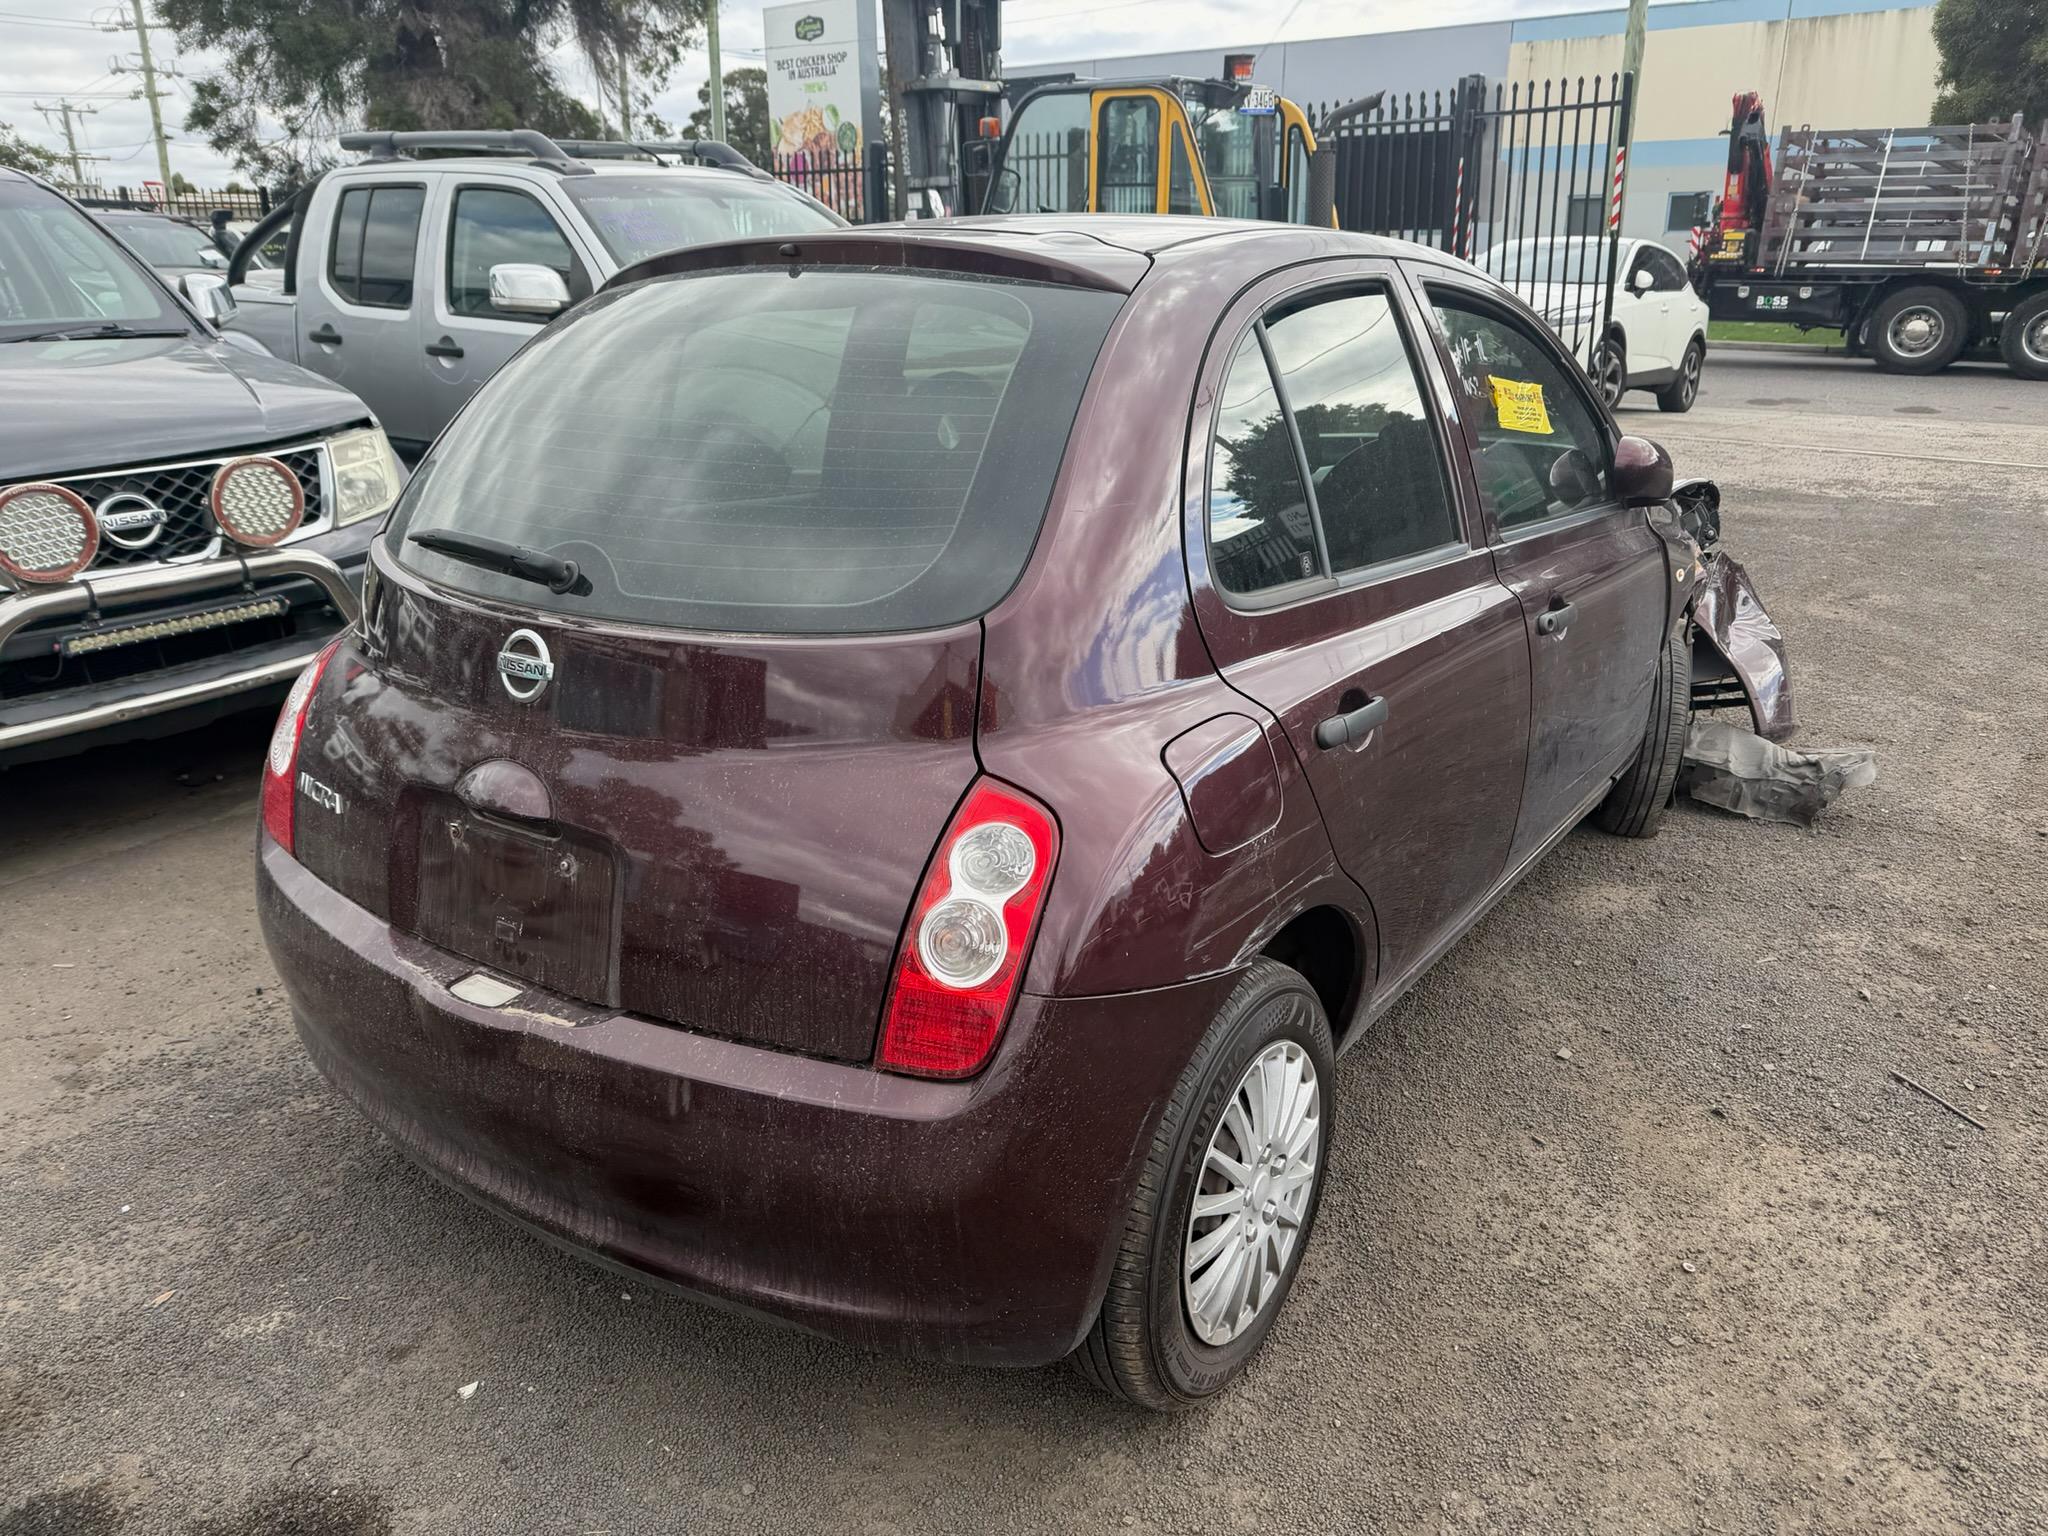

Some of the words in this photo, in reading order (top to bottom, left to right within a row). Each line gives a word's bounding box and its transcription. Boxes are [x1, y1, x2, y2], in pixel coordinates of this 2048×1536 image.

[795, 54, 825, 68] CHICKEN
[827, 51, 848, 64] SHOP
[788, 69, 796, 80] IN
[1756, 296, 1788, 305] BOSS
[102, 511, 161, 528] NISSAN
[500, 655, 545, 676] NISSAN
